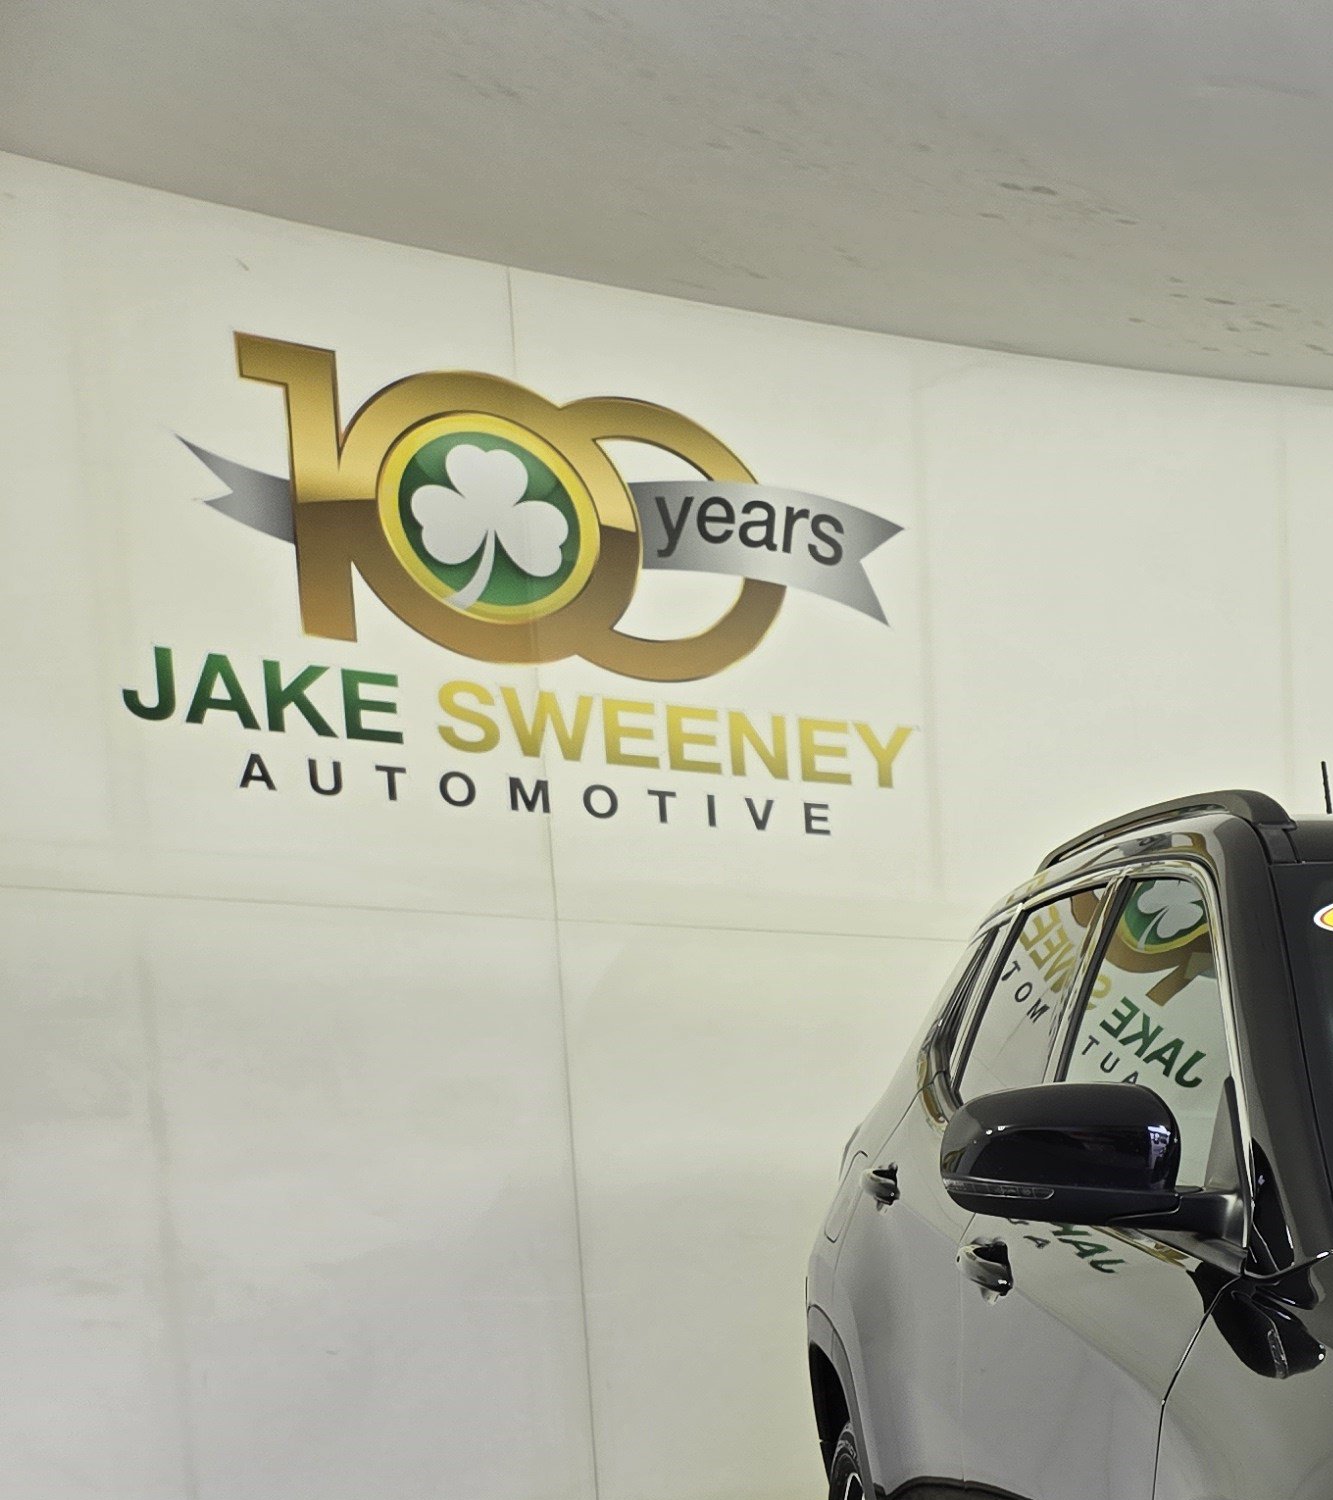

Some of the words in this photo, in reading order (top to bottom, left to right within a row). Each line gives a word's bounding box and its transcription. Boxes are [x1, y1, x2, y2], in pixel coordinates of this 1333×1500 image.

[654, 495, 846, 566] years
[121, 645, 405, 746] JAKE
[437, 680, 912, 789] SWEENEY
[238, 752, 833, 837] AUTOMOTIVE
